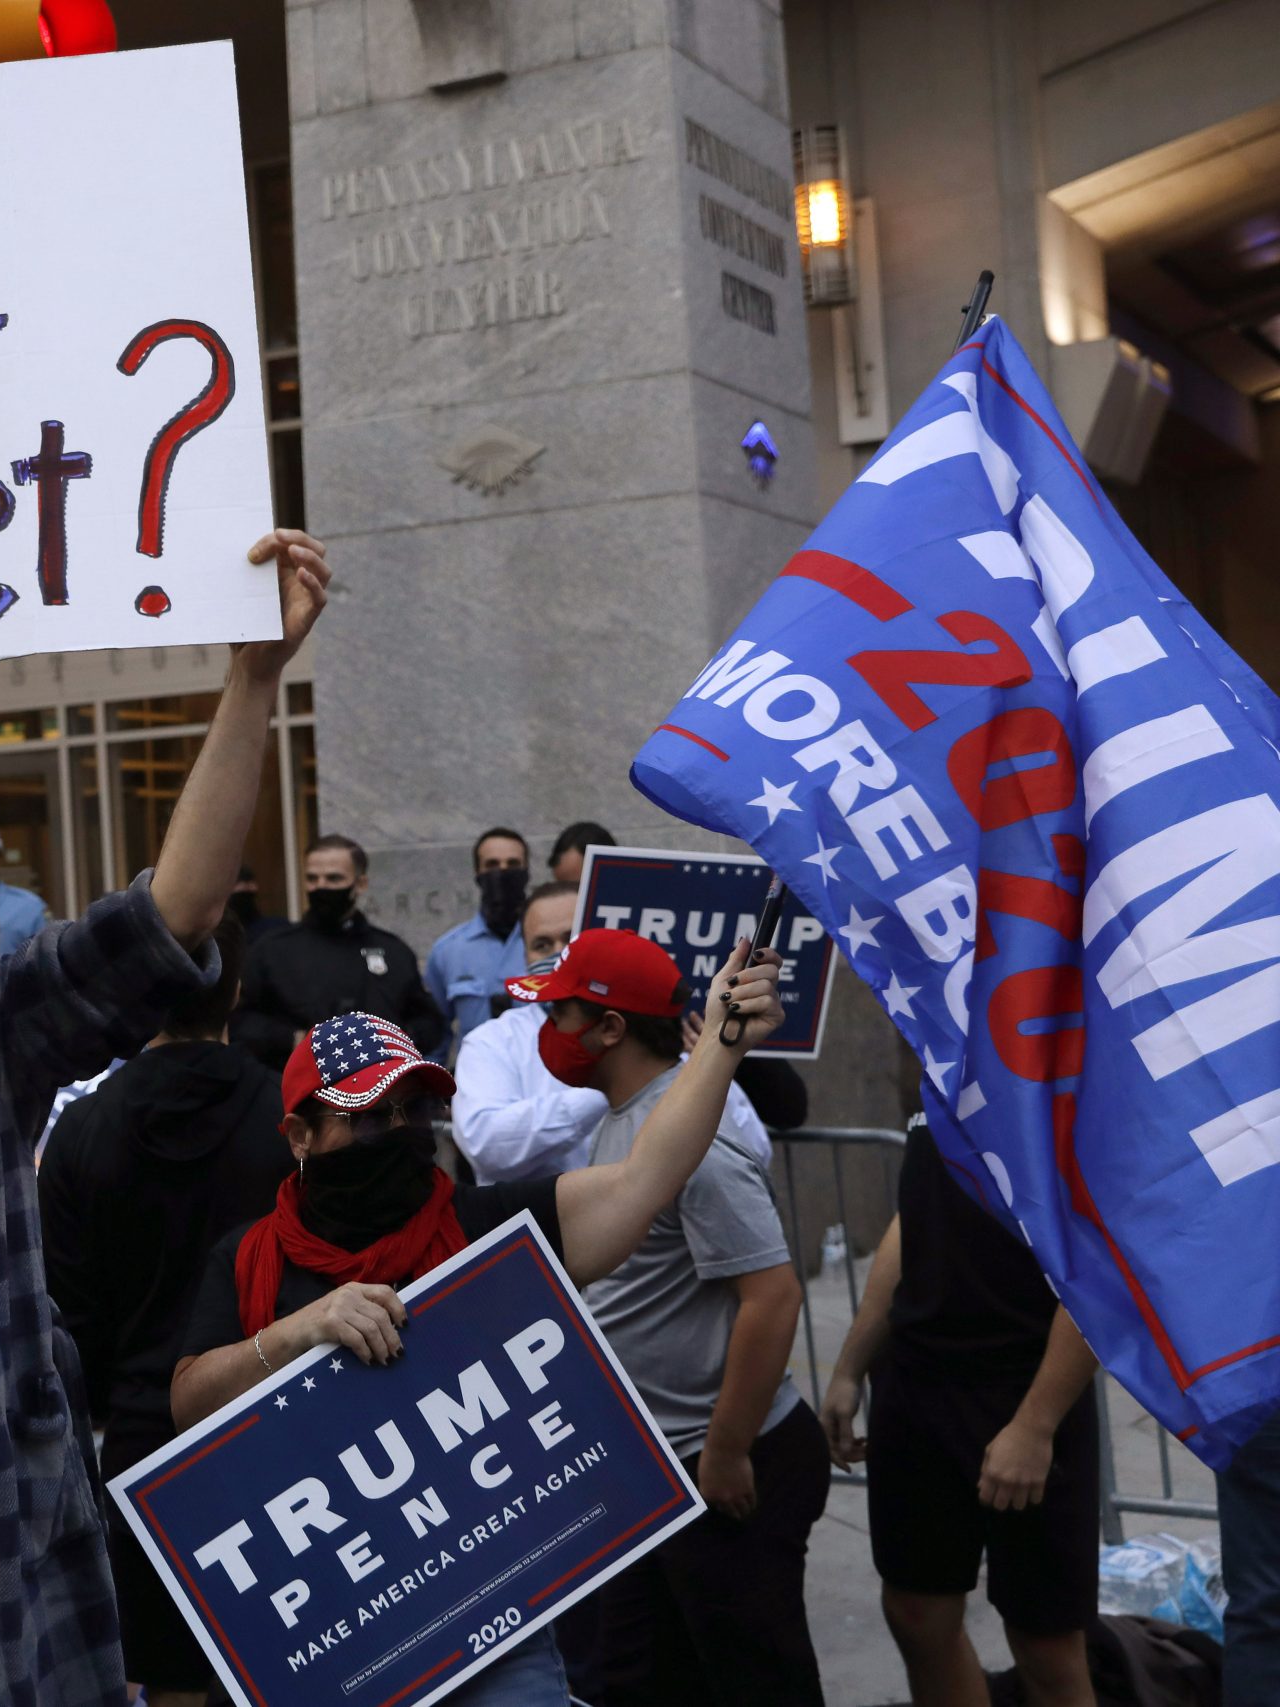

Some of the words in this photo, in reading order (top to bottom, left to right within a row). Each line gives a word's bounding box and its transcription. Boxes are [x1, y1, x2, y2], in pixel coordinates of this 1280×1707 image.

[846, 610, 1087, 1082] 2020
[508, 983, 538, 1000] 2020
[193, 1318, 565, 1594] TRUMP
[269, 1400, 575, 1629] PENCE
[287, 1620, 352, 1672] MAKE
[357, 1551, 456, 1627] AMERICA
[459, 1496, 527, 1553] GREAT
[535, 1441, 609, 1503] AGAIN!
[345, 1678, 357, 1689] Paid
[364, 1668, 373, 1676] by
[581, 1515, 590, 1523] PA
[468, 1606, 522, 1654] 2020
